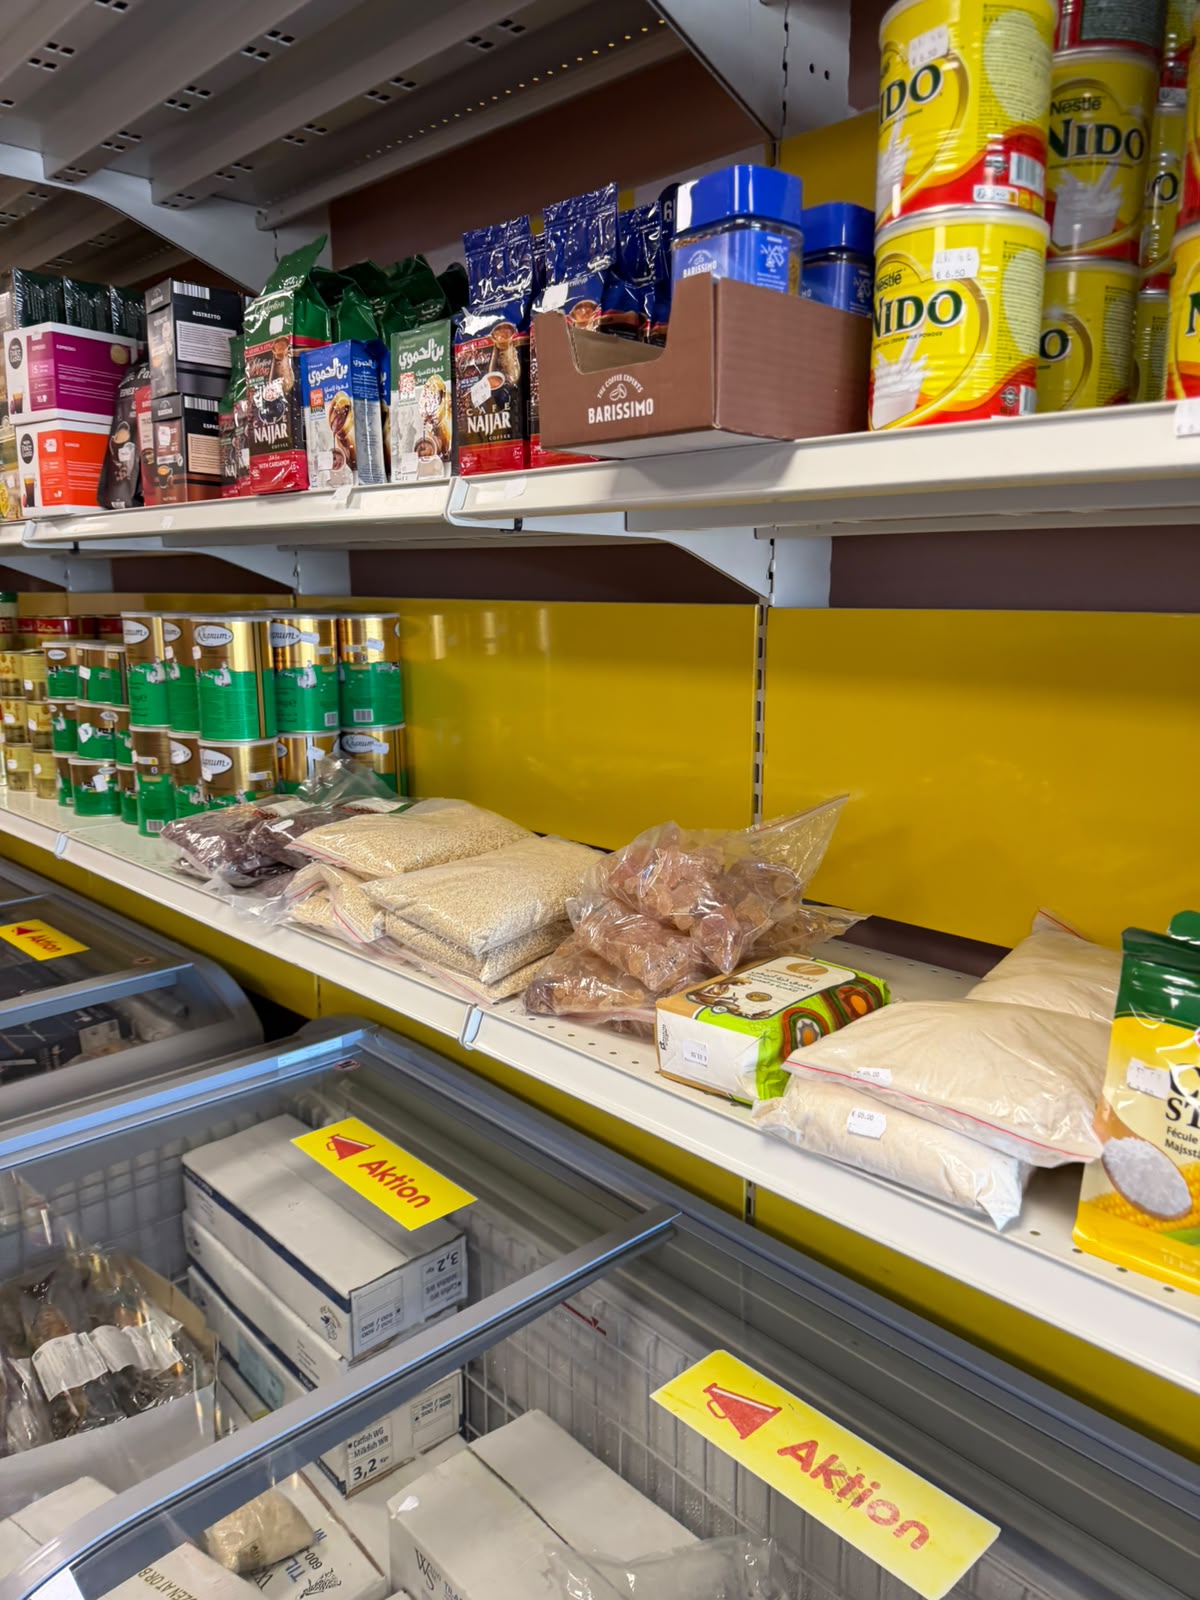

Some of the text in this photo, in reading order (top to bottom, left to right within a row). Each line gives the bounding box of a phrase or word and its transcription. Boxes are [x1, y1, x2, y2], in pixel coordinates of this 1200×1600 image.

[1049, 118, 1145, 161] NIDO
[683, 260, 718, 279] BARISSIMO
[192, 310, 222, 321] RISTRETTO
[596, 374, 644, 399] THE COFFEE EXPERTS
[466, 403, 511, 417] CAFE
[588, 398, 654, 425] BARISSIMO
[467, 412, 512, 435] NAJJAR
[254, 424, 289, 445] NAJJAR
[489, 433, 511, 441] COFFEE
[28, 934, 62, 953] Aktion
[1166, 1126, 1199, 1145] Fécule
[357, 1159, 431, 1209] Aktion
[353, 1427, 385, 1447] Catfish WG
[353, 1441, 378, 1459] Milkfish
[353, 1458, 377, 1481] 3,2
[776, 1438, 931, 1551] Aktion
[137, 1567, 154, 1578] B
[144, 1571, 165, 1586] OR
[285, 1558, 306, 1583] TIL
[155, 1580, 177, 1592] AT
